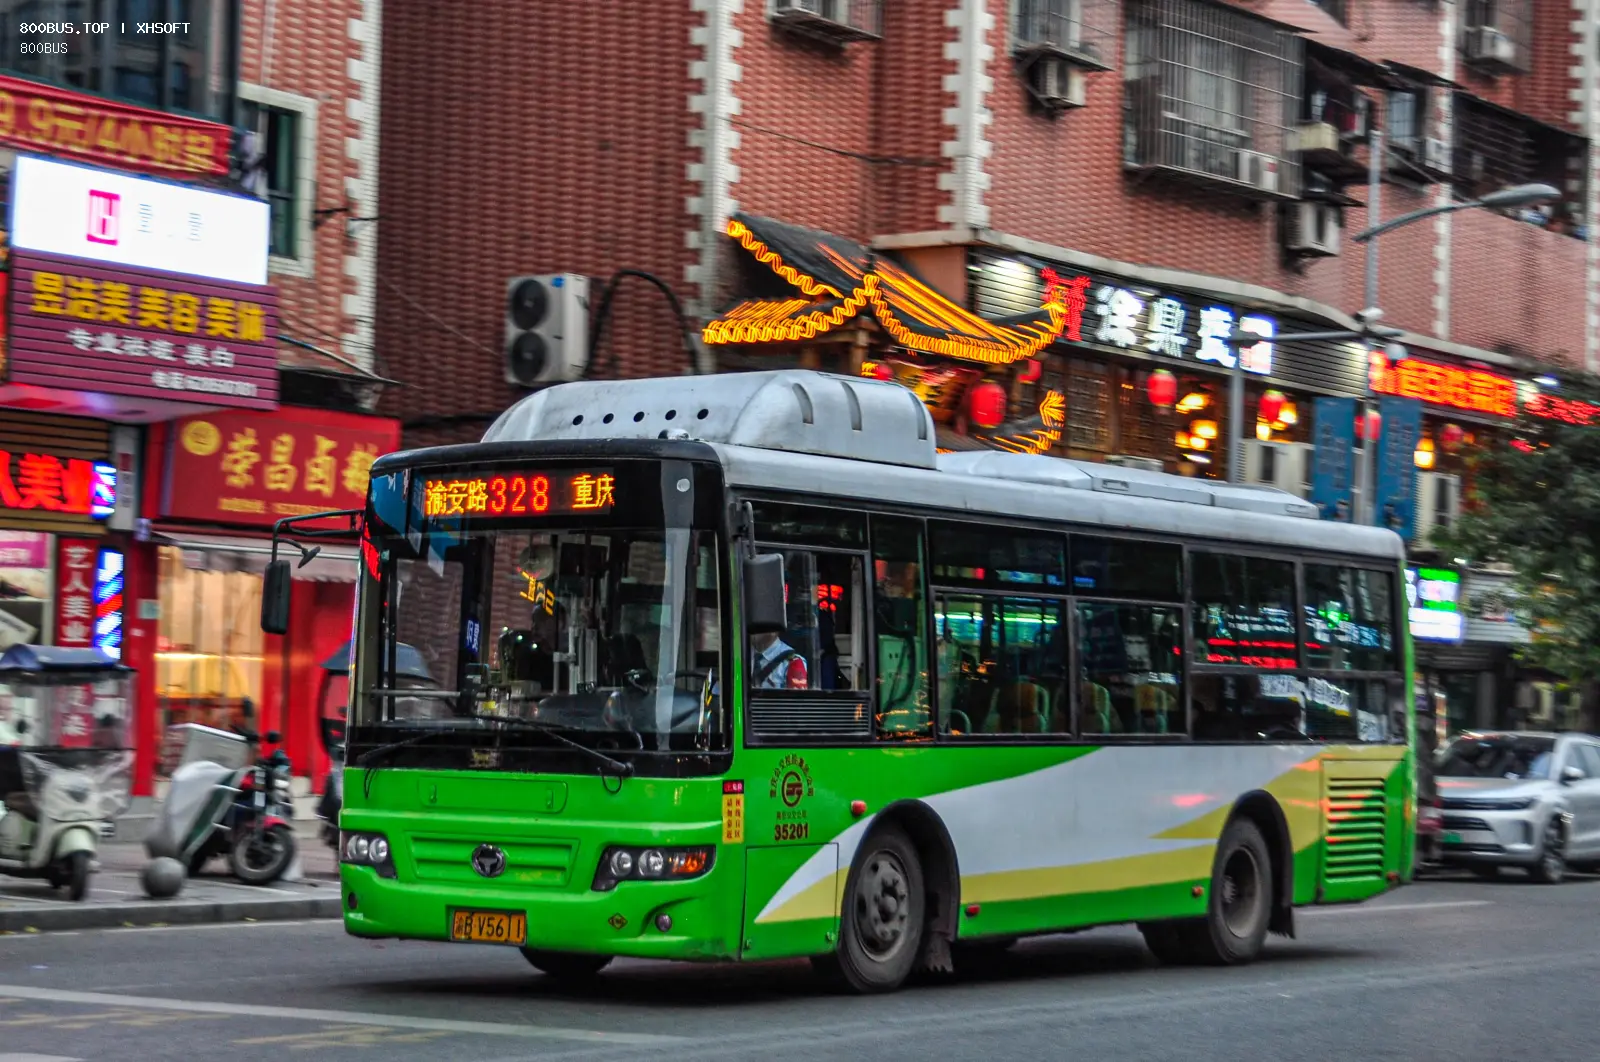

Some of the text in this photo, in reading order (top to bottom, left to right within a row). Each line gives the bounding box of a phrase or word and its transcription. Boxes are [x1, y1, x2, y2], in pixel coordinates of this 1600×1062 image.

[137, 286, 201, 334] 美容
[490, 475, 549, 514] 328
[572, 474, 615, 508] 重庆
[774, 822, 809, 841] 35201
